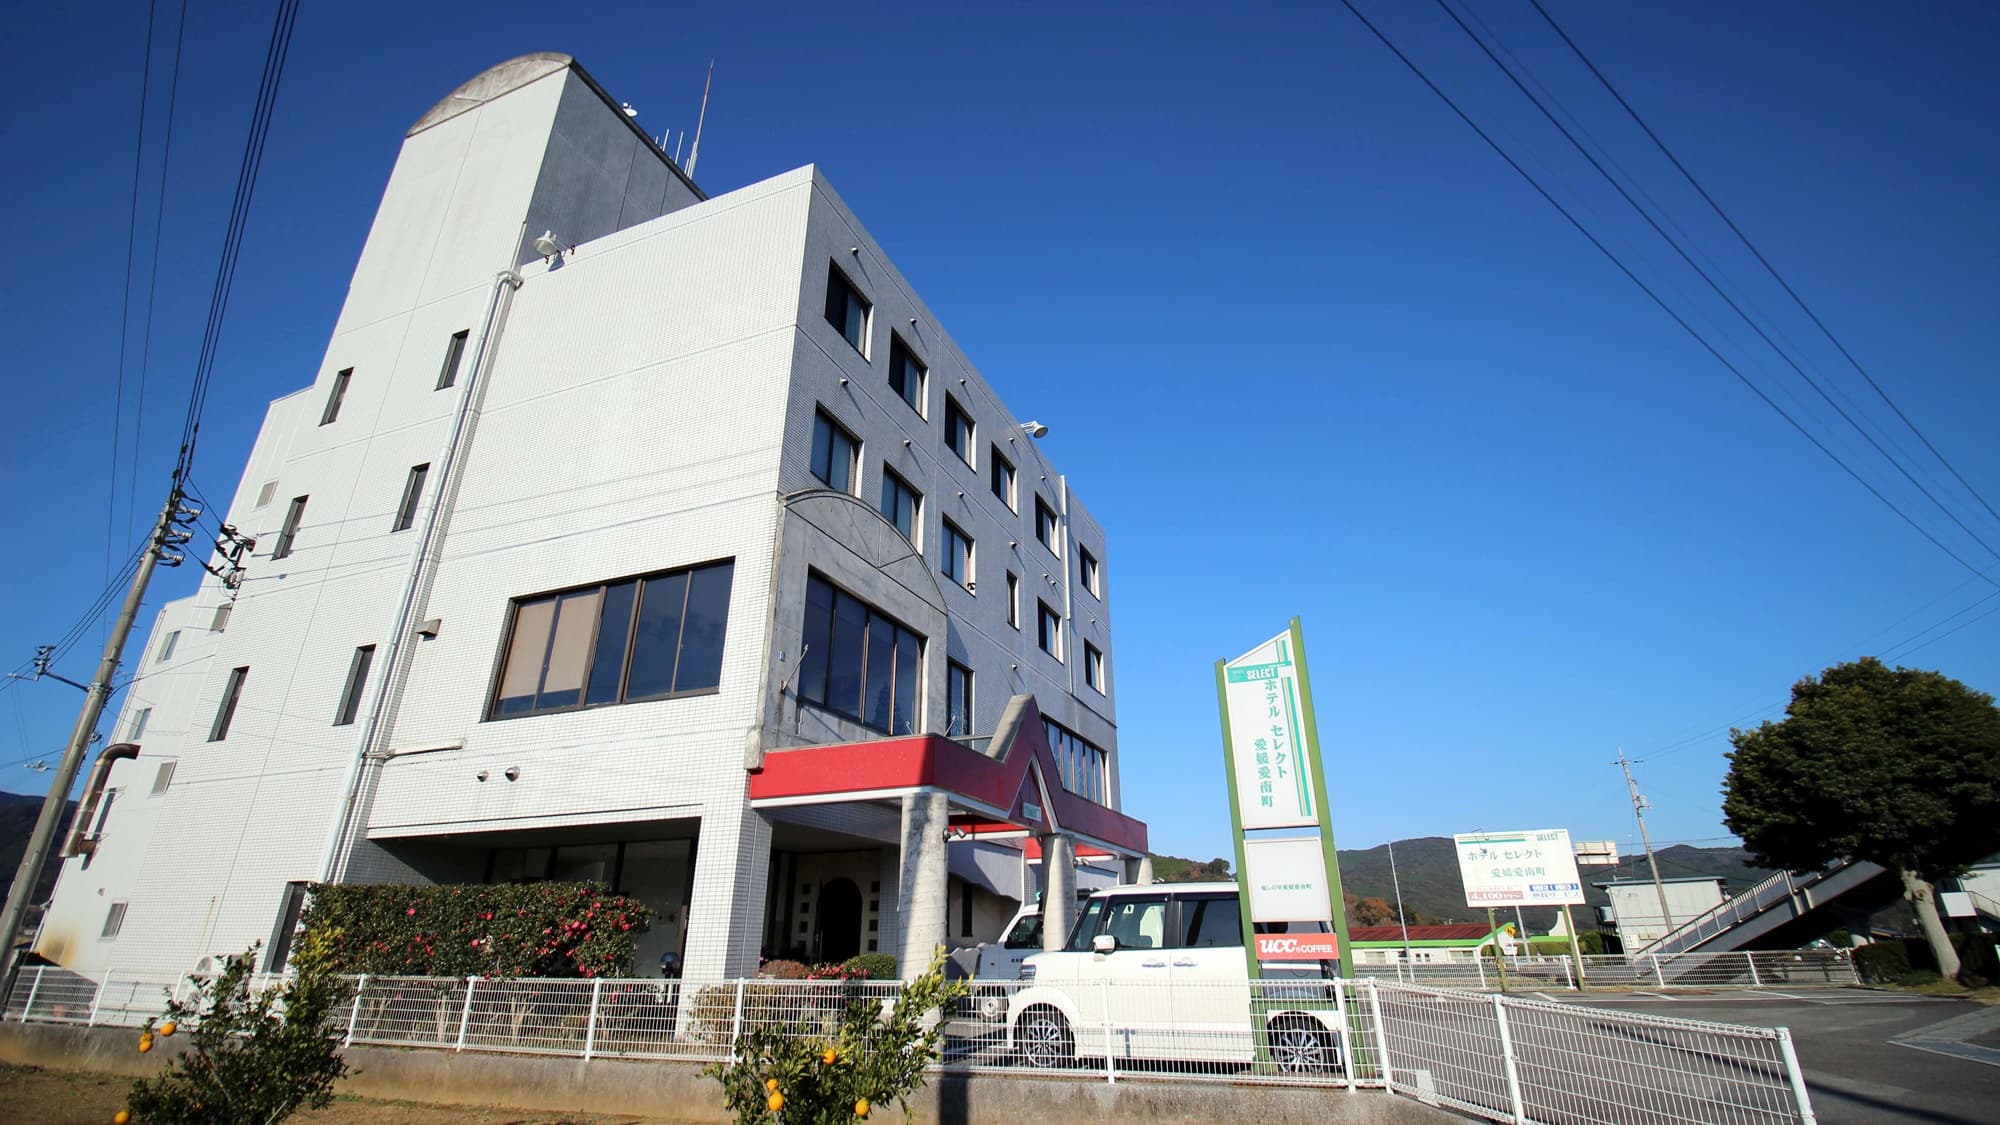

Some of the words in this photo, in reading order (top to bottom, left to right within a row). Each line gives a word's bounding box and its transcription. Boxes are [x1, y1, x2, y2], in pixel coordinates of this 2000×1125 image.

[1246, 668, 1276, 680] SELECT
[1264, 680, 1281, 717] ホテル
[1271, 724, 1288, 779] セレクト
[1254, 738, 1274, 807] 愛媛愛南町
[1503, 848, 1543, 860] セレクト
[1260, 938, 1297, 953] UCC
[1301, 944, 1333, 953] COFFEE
